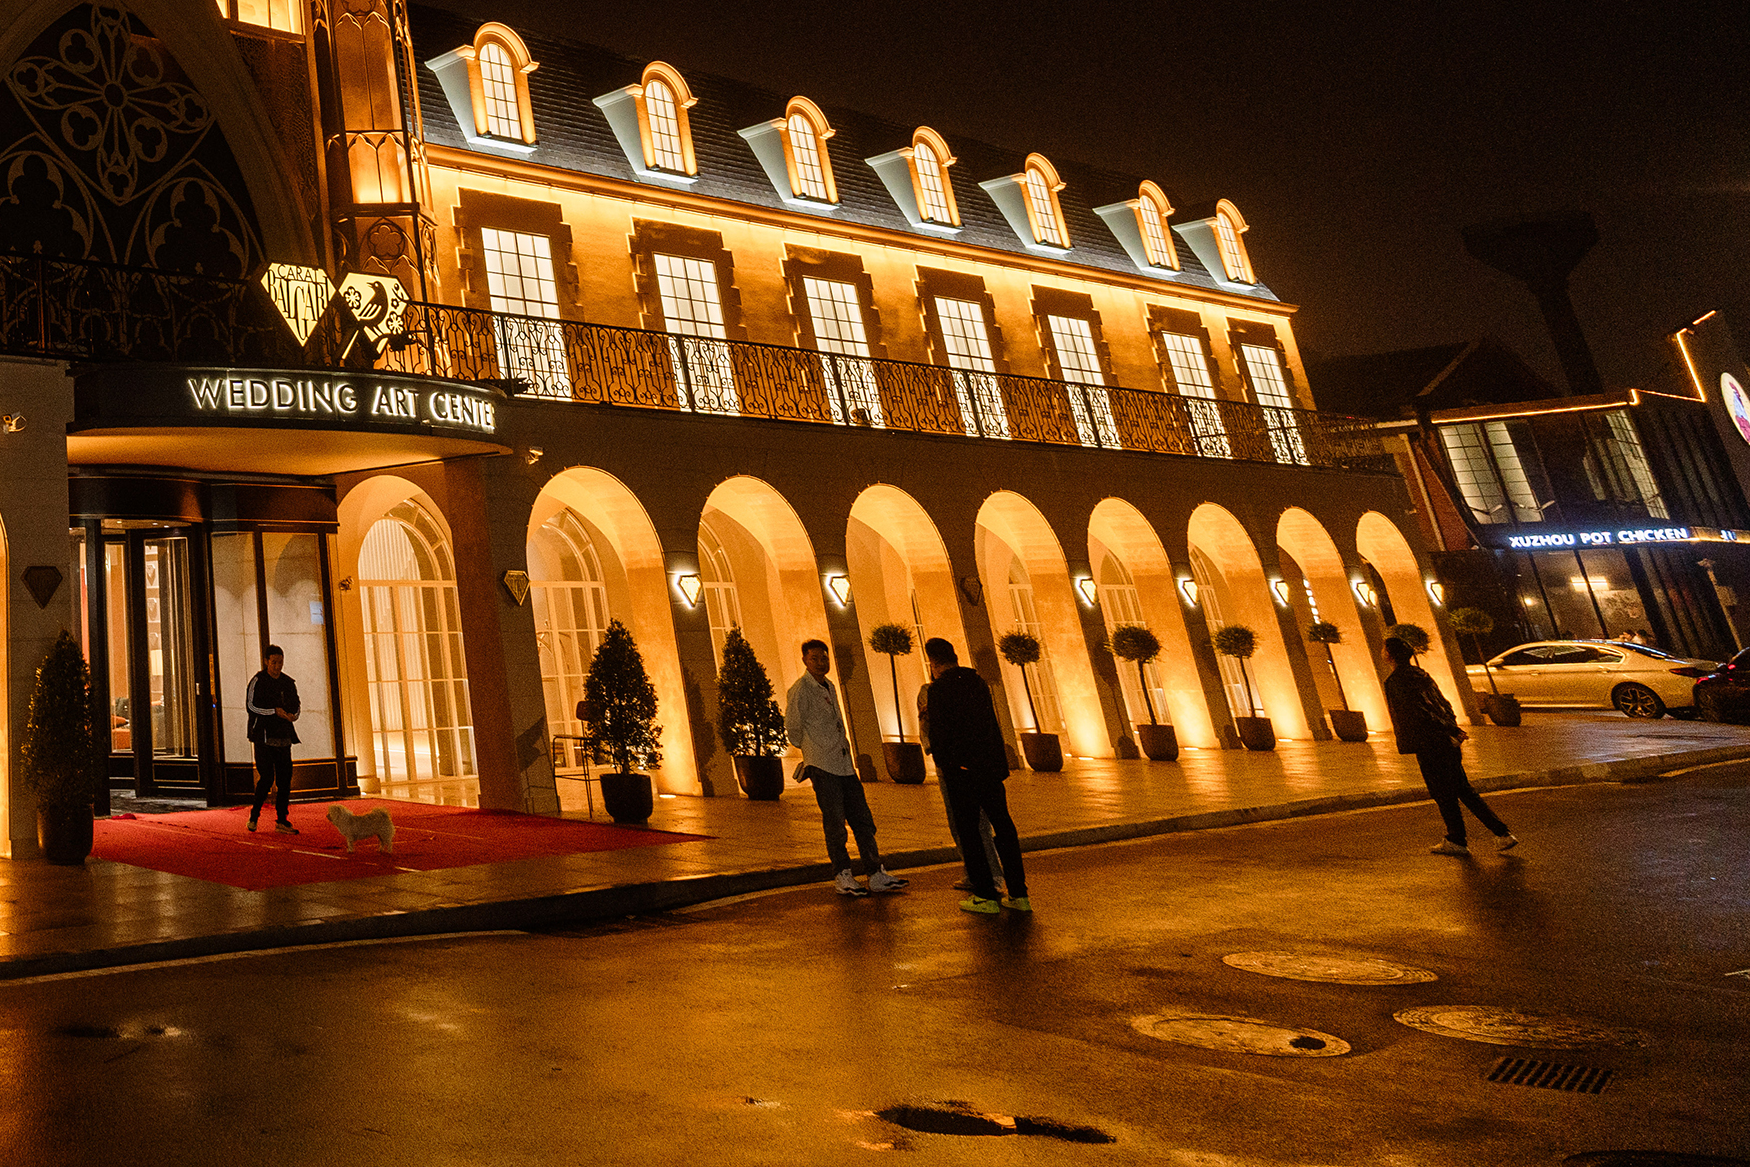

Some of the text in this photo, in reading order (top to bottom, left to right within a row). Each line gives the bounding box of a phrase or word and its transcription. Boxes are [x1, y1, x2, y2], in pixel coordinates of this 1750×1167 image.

[188, 379, 496, 430] WEDDING ART CENTE
[1509, 527, 1689, 548] XUZHOU POT CHICKEN
